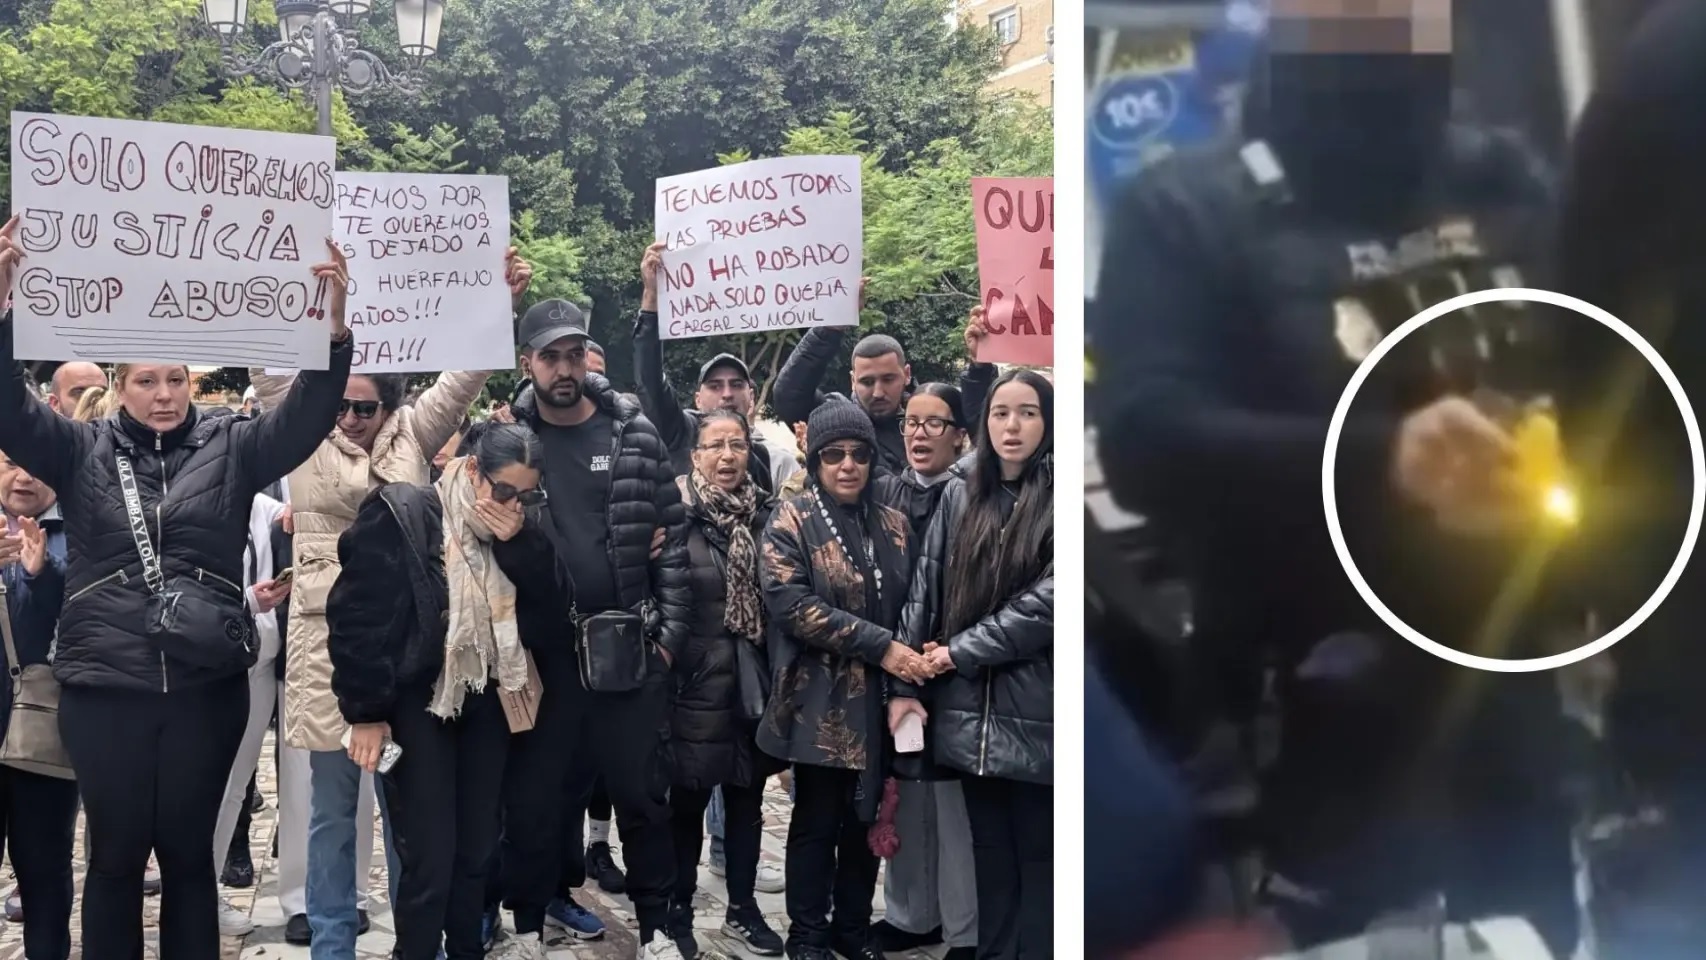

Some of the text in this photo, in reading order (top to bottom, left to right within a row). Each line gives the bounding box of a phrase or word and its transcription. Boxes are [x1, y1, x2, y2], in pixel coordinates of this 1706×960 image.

[20, 118, 334, 209] SOLO QUEREMOS
[336, 183, 486, 211] REMOS POR
[661, 172, 853, 213] TENEMOS TODAS
[339, 211, 492, 235] TE QUEREMOS
[664, 205, 807, 252] LAS PRUEBAS
[368, 234, 464, 260] DEJADO
[477, 232, 491, 248] A
[661, 243, 850, 292] NO HA ROBADO
[20, 267, 327, 322] STOP ABUSO!!
[669, 291, 722, 319] NADA
[724, 284, 766, 309] SOLO
[669, 304, 824, 337] CARGAR SU MÓVIL
[592, 455, 611, 463] DOLC
[117, 456, 132, 482] LOLA
[139, 539, 156, 577] LOLA
